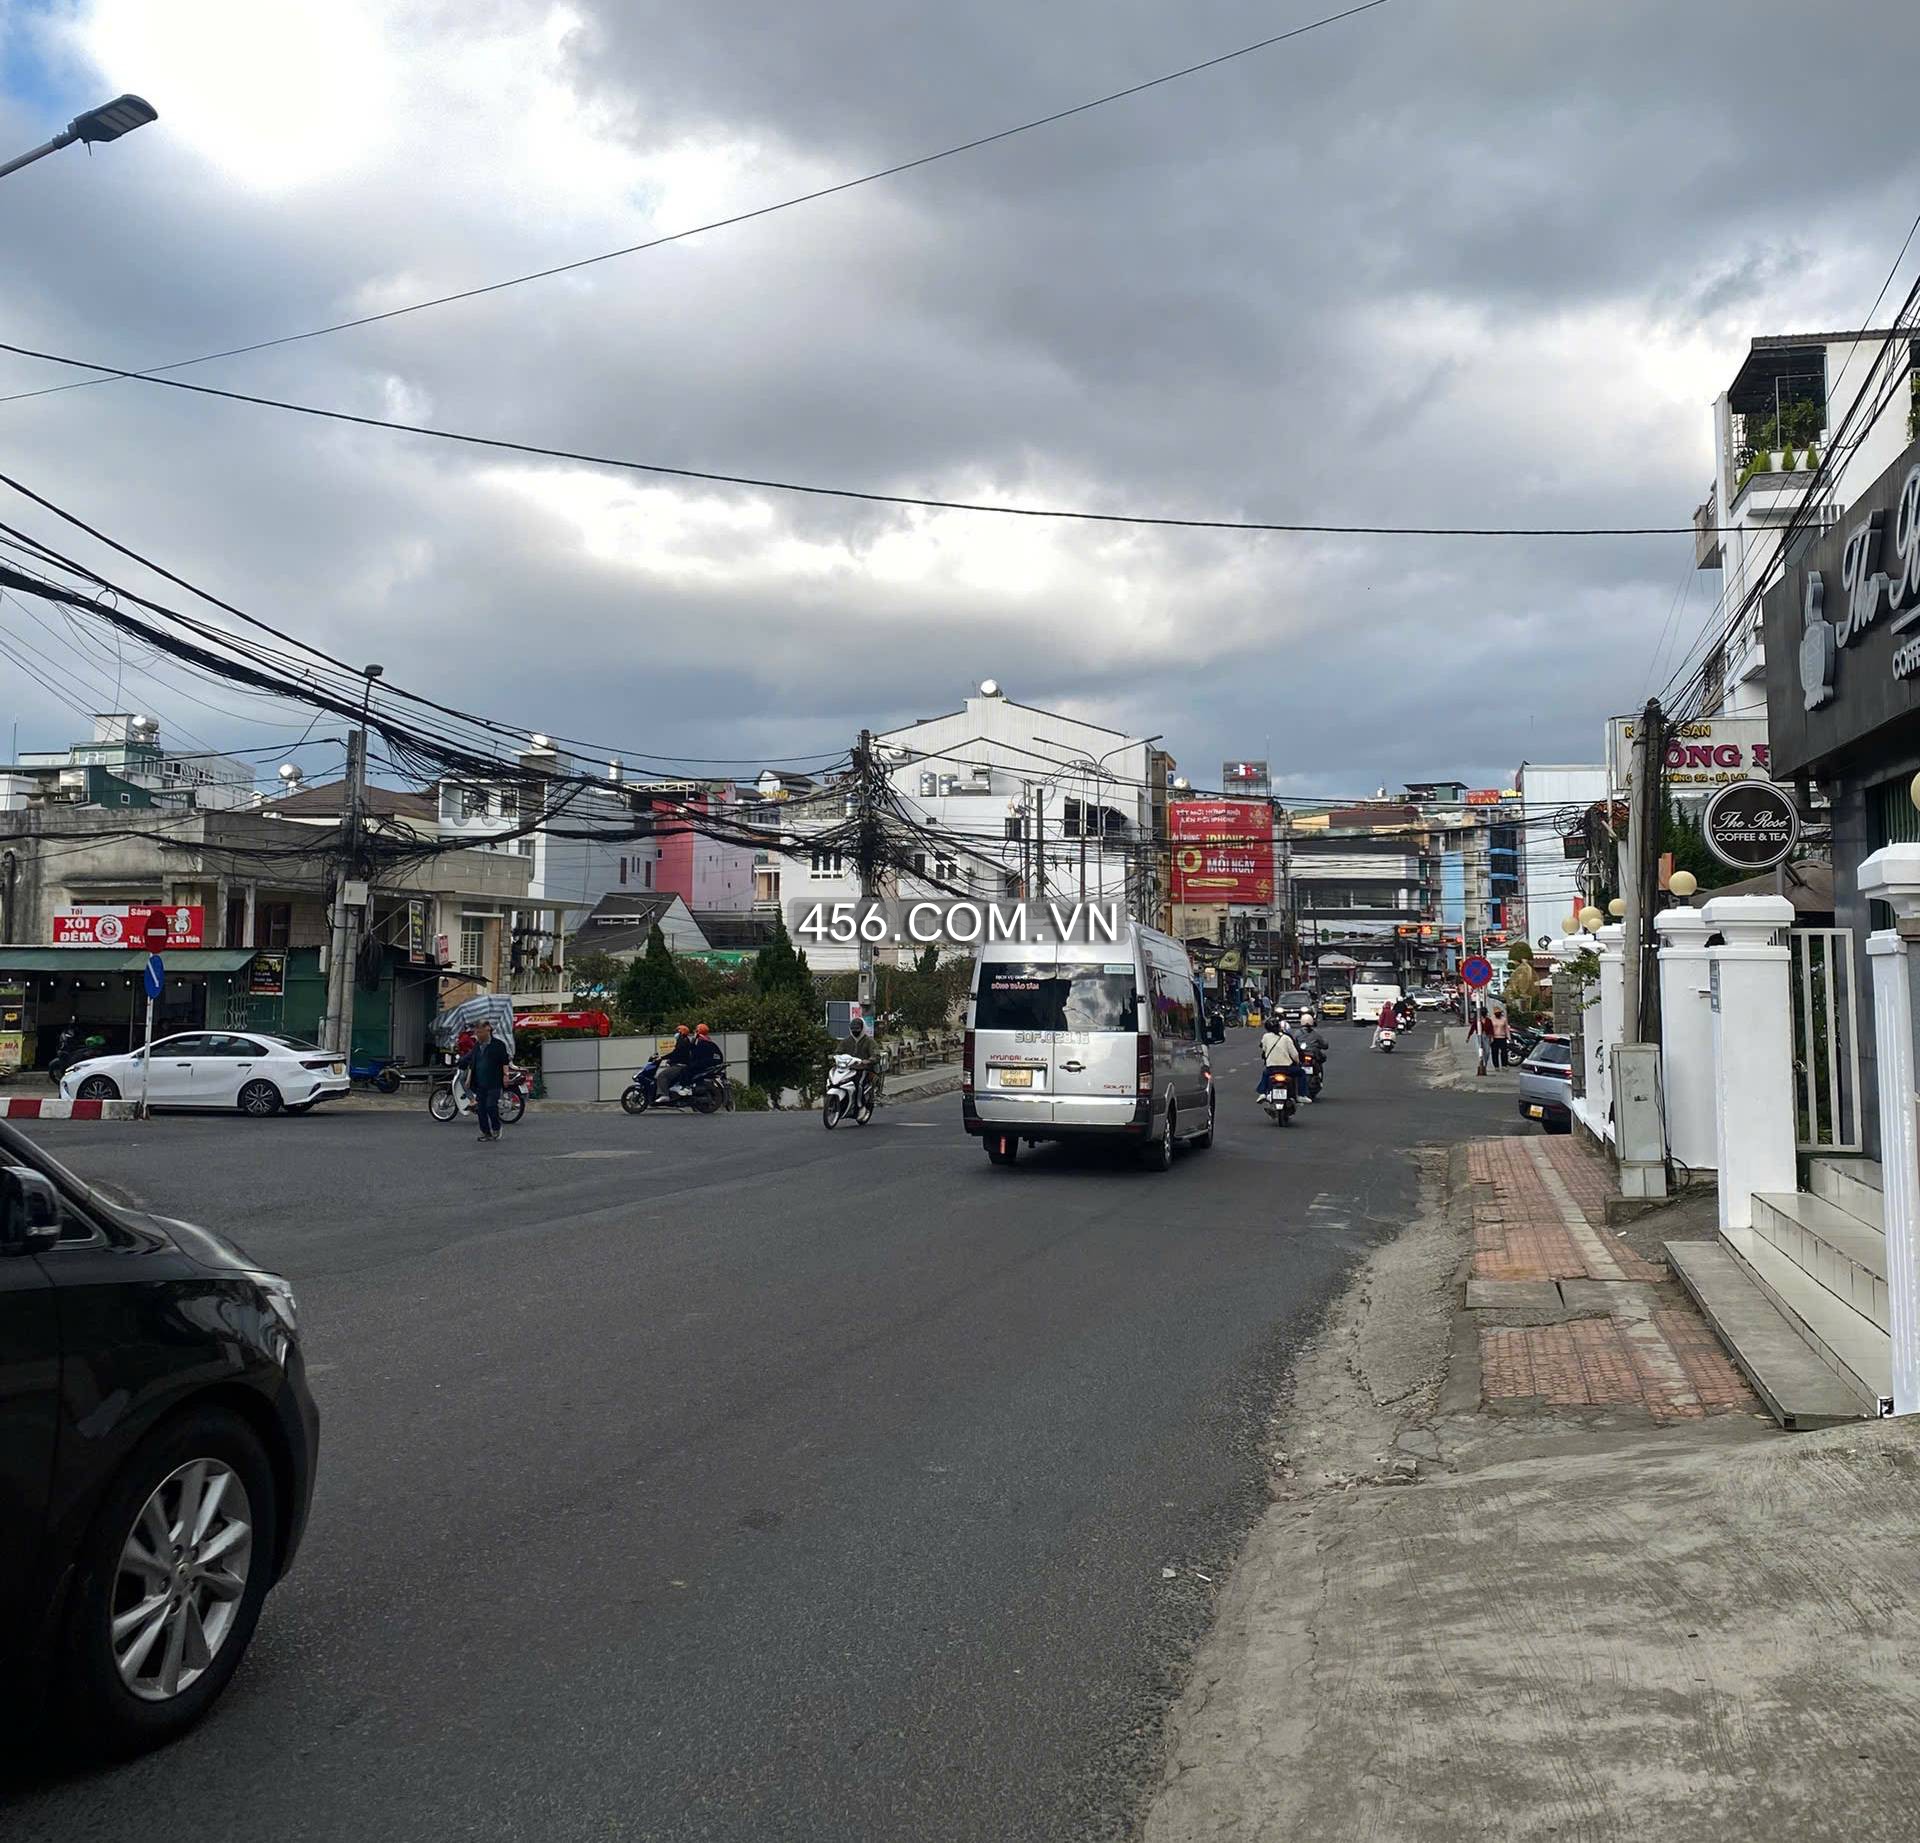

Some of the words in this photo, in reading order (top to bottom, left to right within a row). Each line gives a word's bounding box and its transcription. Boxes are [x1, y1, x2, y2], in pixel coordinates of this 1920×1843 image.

[1665, 740, 1742, 768] ÔNG
[1713, 811, 1745, 828] The
[1748, 811, 1790, 828] Rosé
[1716, 832, 1756, 841] COFFEE
[1758, 832, 1767, 841] &
[1769, 832, 1788, 841] TEA
[64, 916, 90, 929] XÔI
[59, 930, 93, 942] ĐÊM
